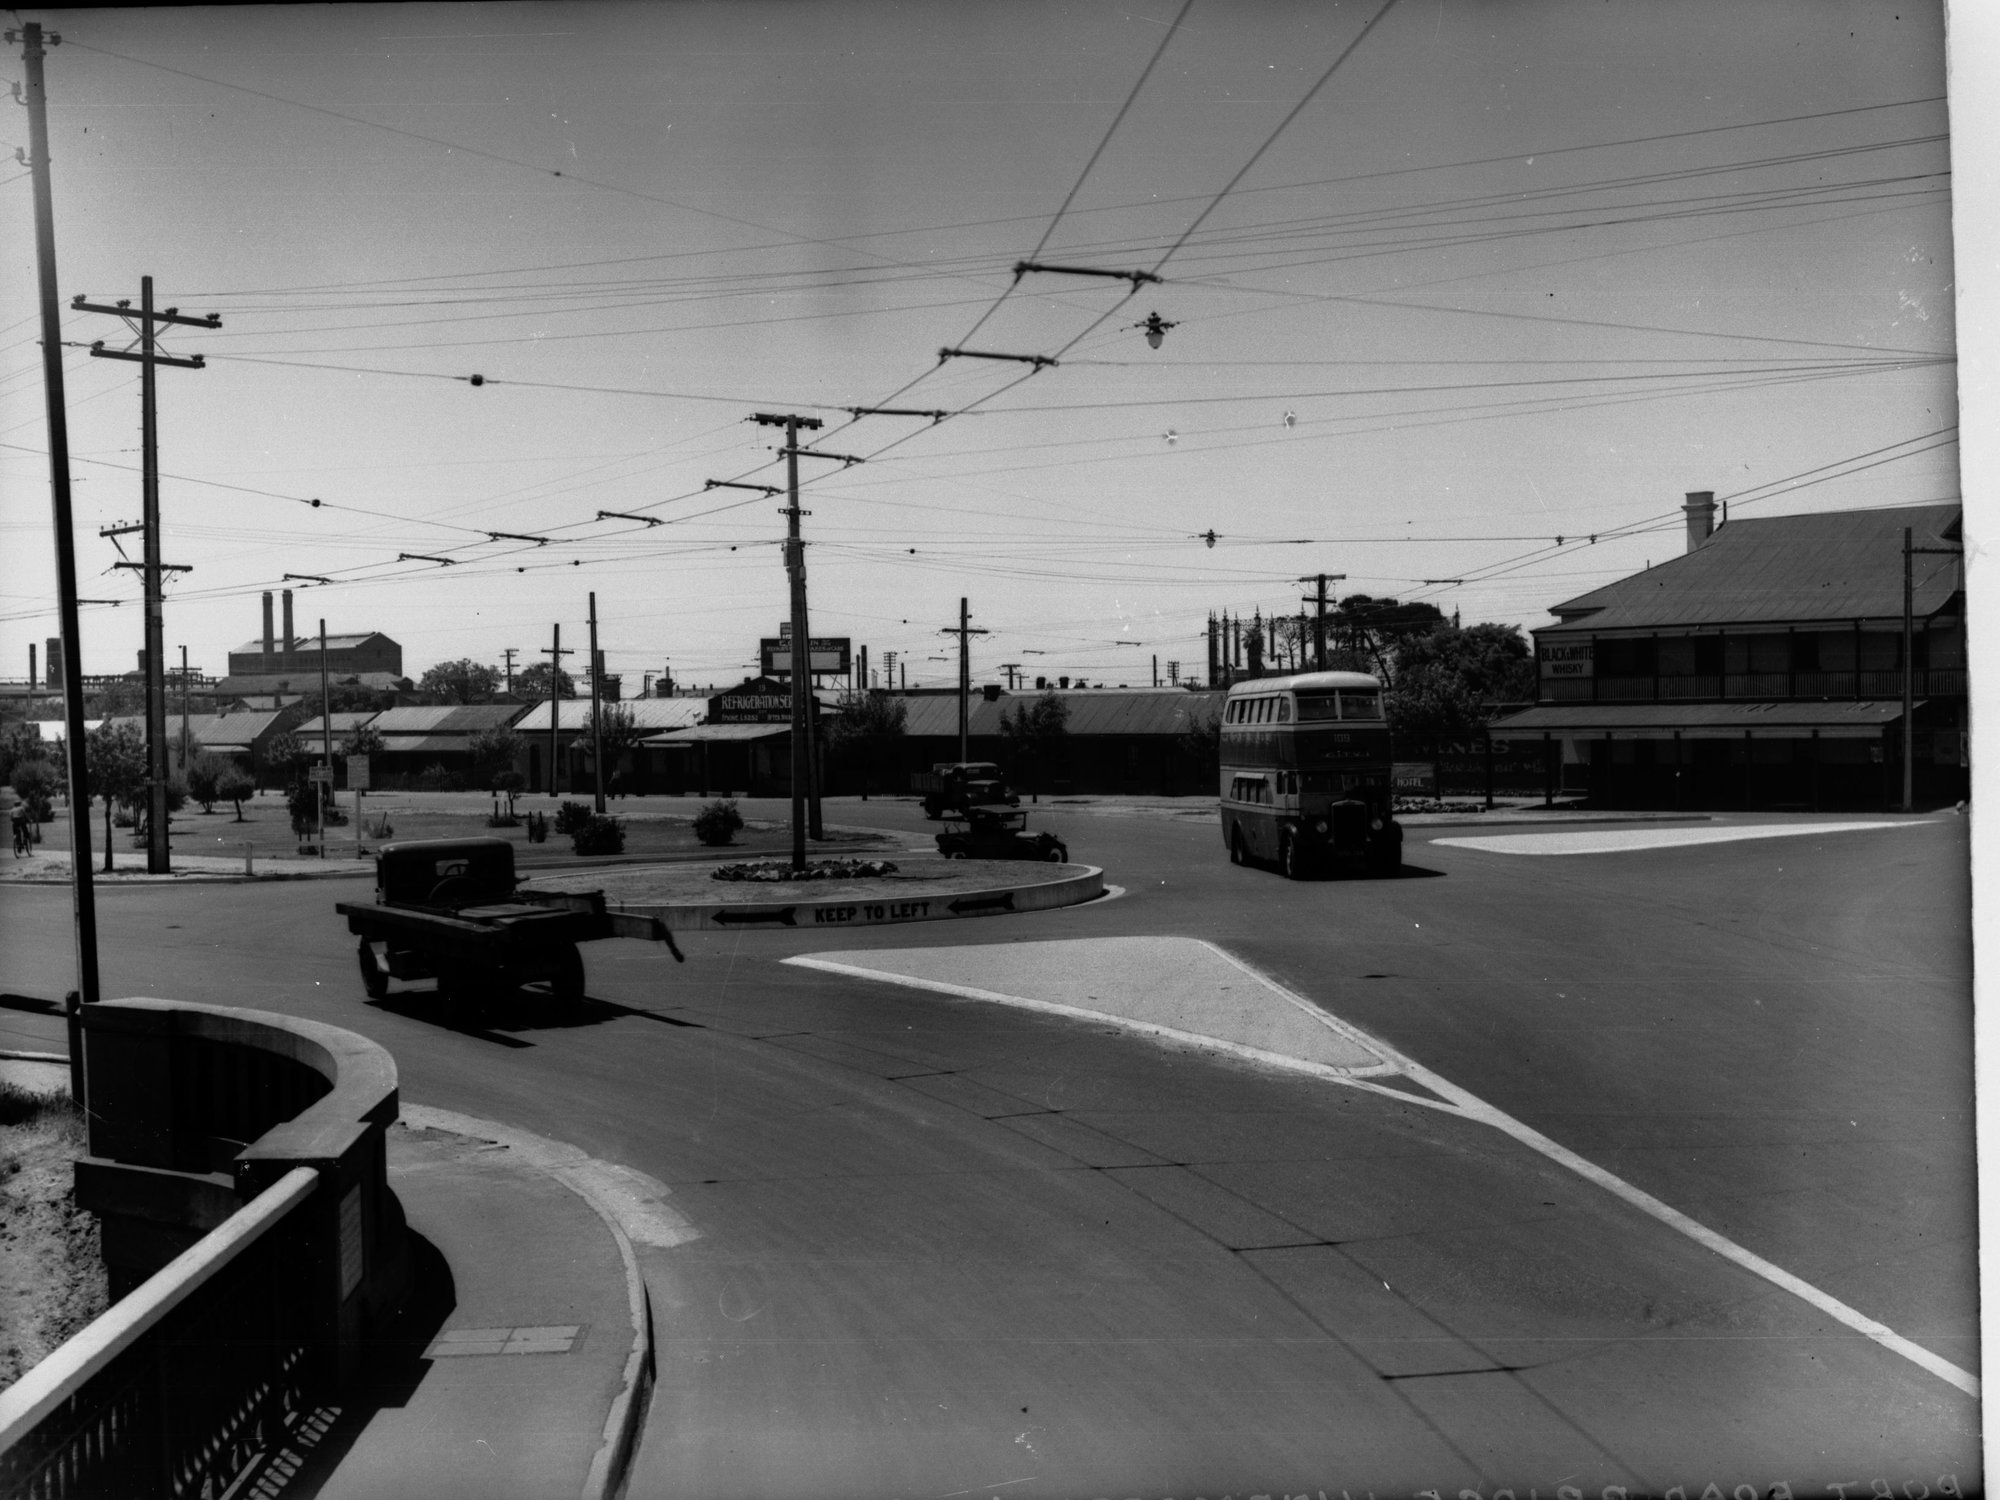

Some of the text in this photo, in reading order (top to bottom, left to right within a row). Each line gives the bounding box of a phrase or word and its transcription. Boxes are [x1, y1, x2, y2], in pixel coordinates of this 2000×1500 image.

[1552, 663, 1584, 674] WHISKY
[721, 694, 779, 709] REFRIGERATION
[1396, 778, 1425, 787] HOTEL
[815, 901, 930, 923] KEEP TO LEFT
